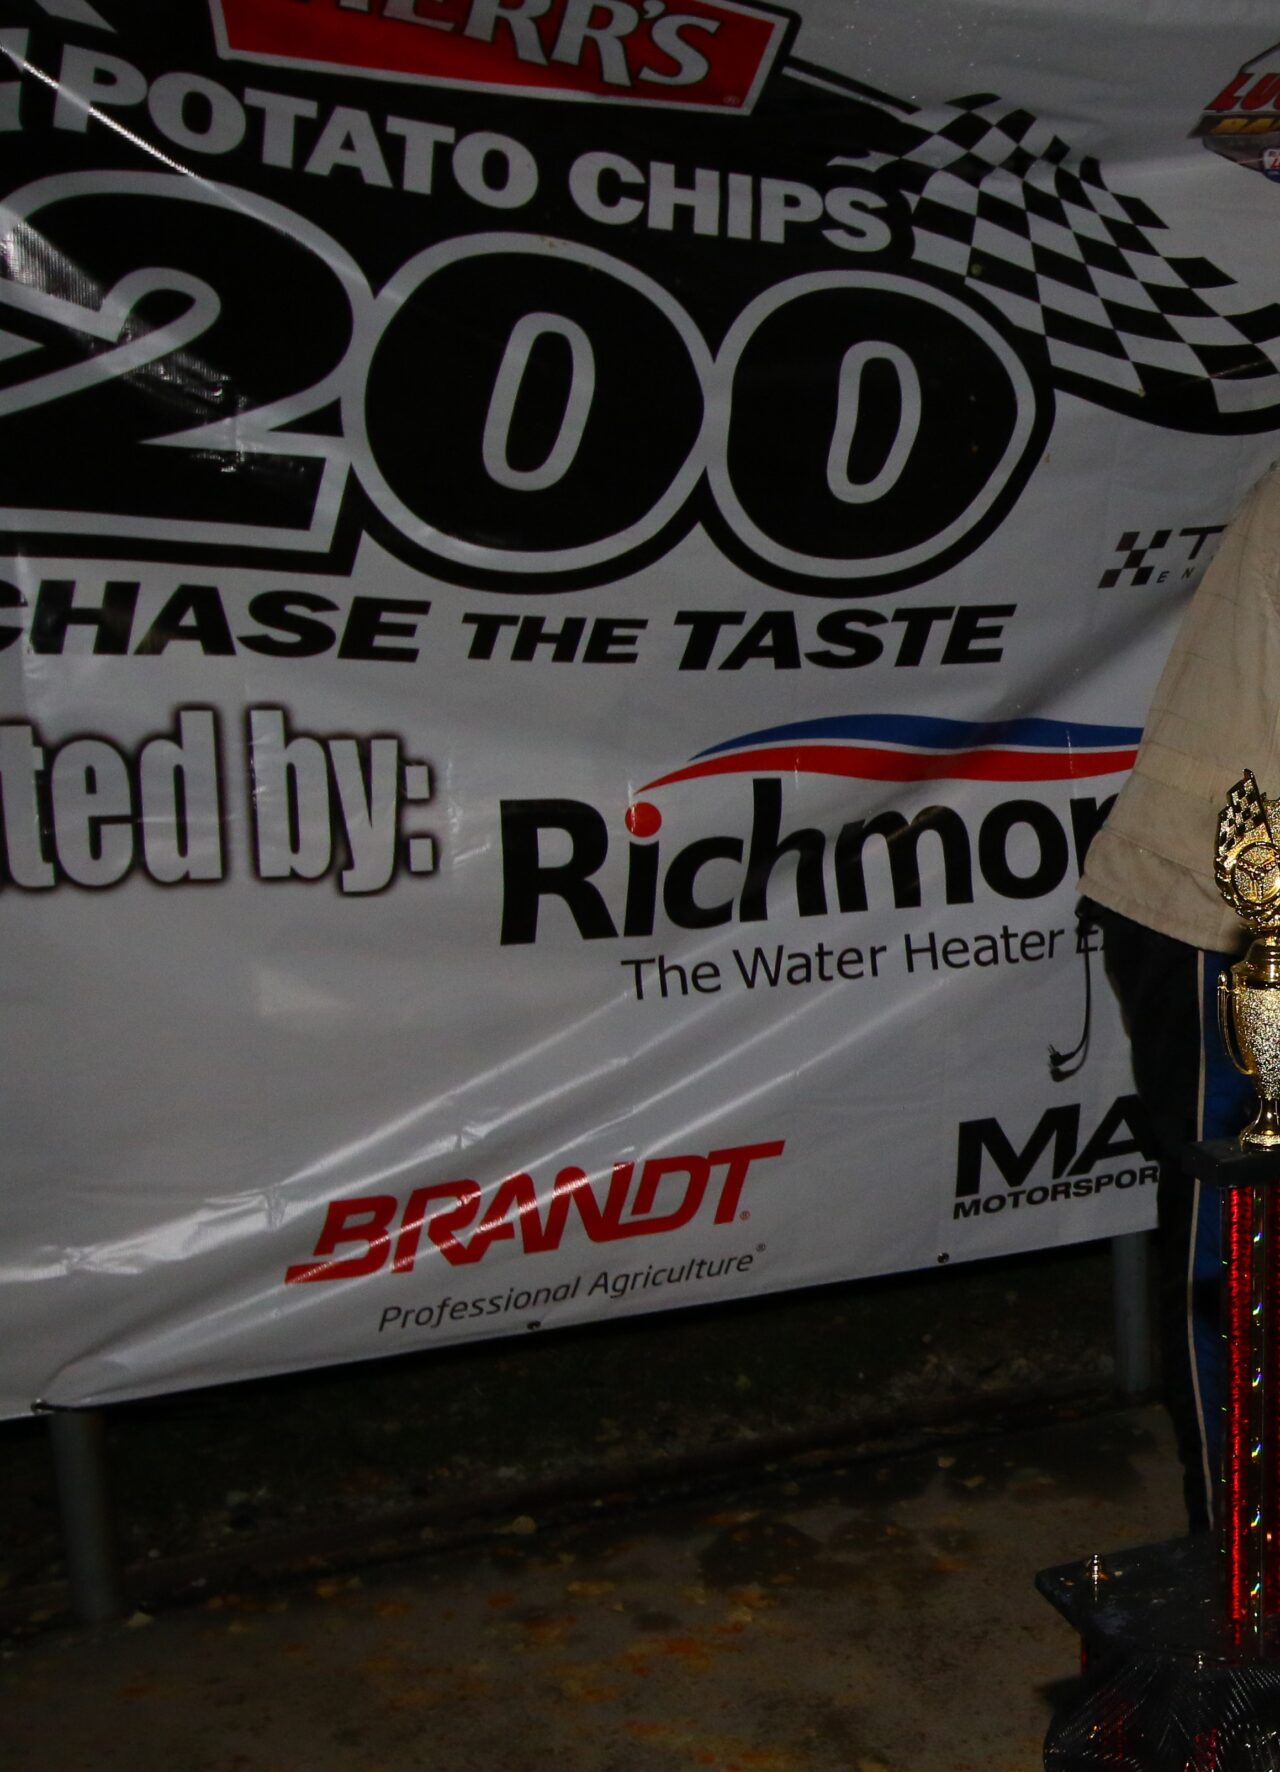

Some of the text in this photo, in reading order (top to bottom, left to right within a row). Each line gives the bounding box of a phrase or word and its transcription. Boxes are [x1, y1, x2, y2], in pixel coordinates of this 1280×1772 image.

[338, 0, 721, 87] RR'S
[52, 43, 540, 210] POTATO
[568, 150, 893, 252] CHIPS
[462, 612, 647, 665] THE
[673, 603, 1017, 671] TASTE
[247, 706, 438, 896] by:
[621, 954, 722, 1001] The
[733, 940, 887, 989] Water
[904, 924, 1065, 973] Heater
[284, 1140, 785, 1285] BRANDT
[378, 1251, 755, 1332] Professional Agriculture
